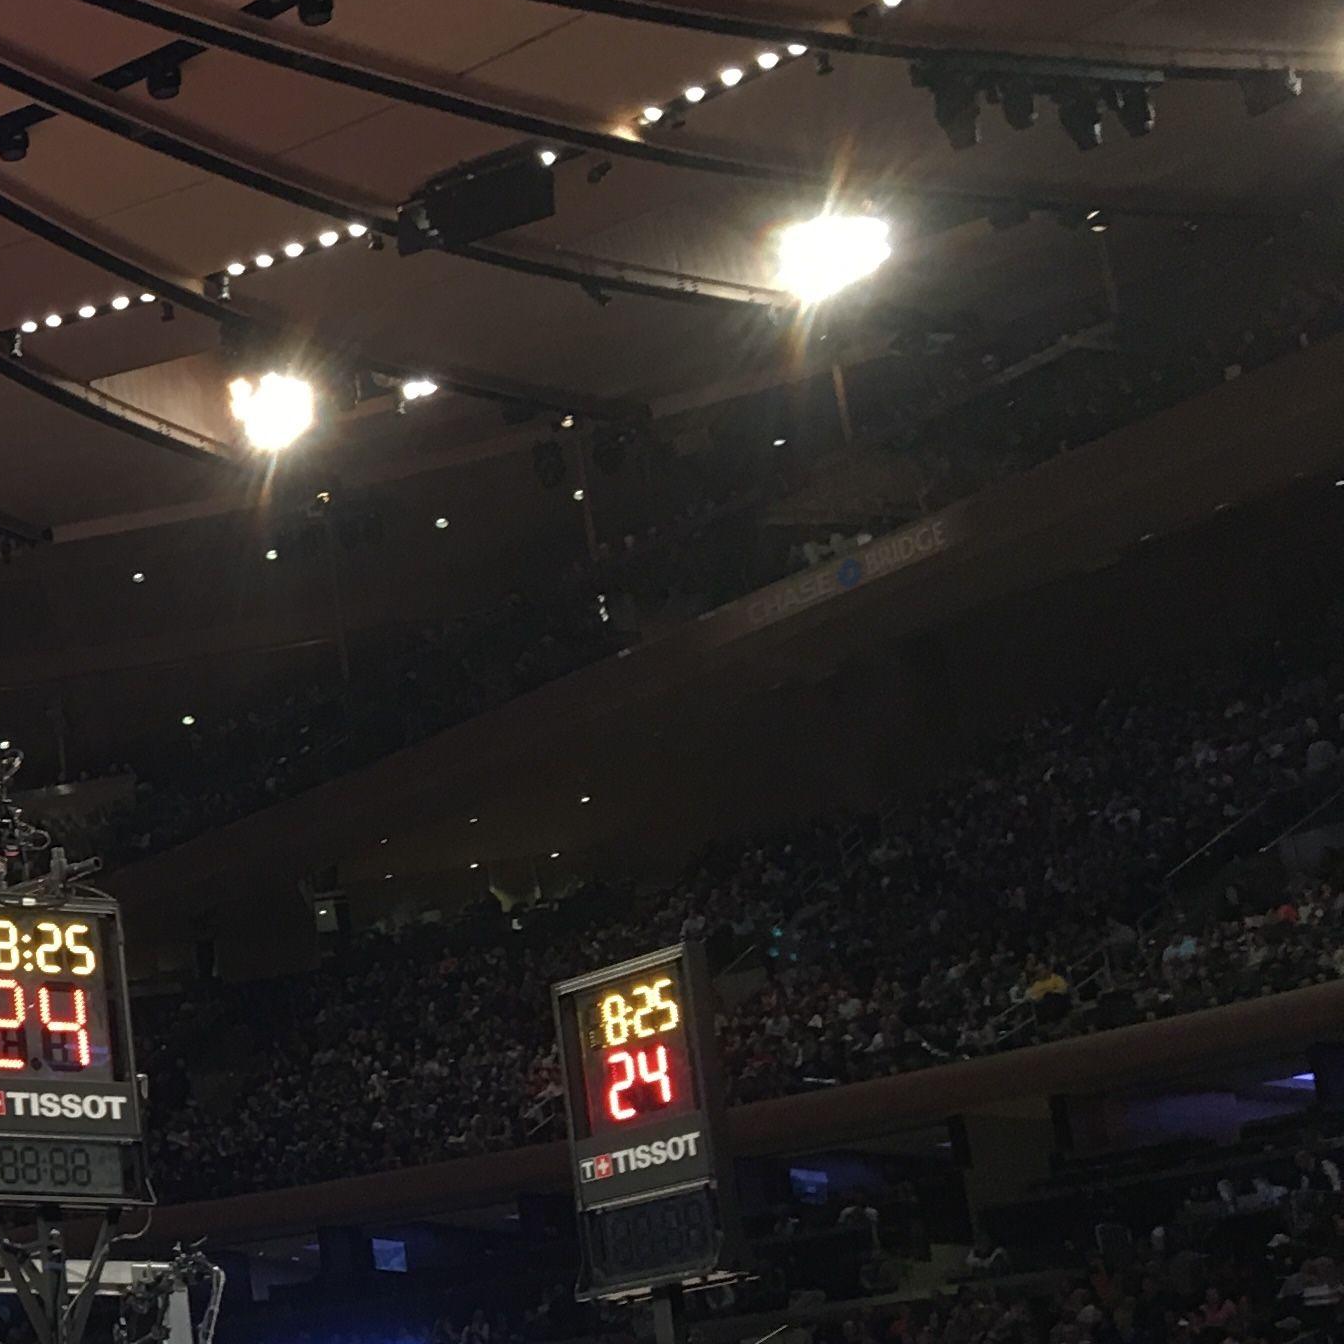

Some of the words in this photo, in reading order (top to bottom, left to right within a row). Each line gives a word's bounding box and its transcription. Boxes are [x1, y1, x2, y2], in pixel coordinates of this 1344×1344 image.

[601, 977, 680, 1047] 8:25
[6, 1091, 127, 1119] TISSOT
[607, 1044, 673, 1122] 24
[612, 1131, 702, 1176] TISSOT
